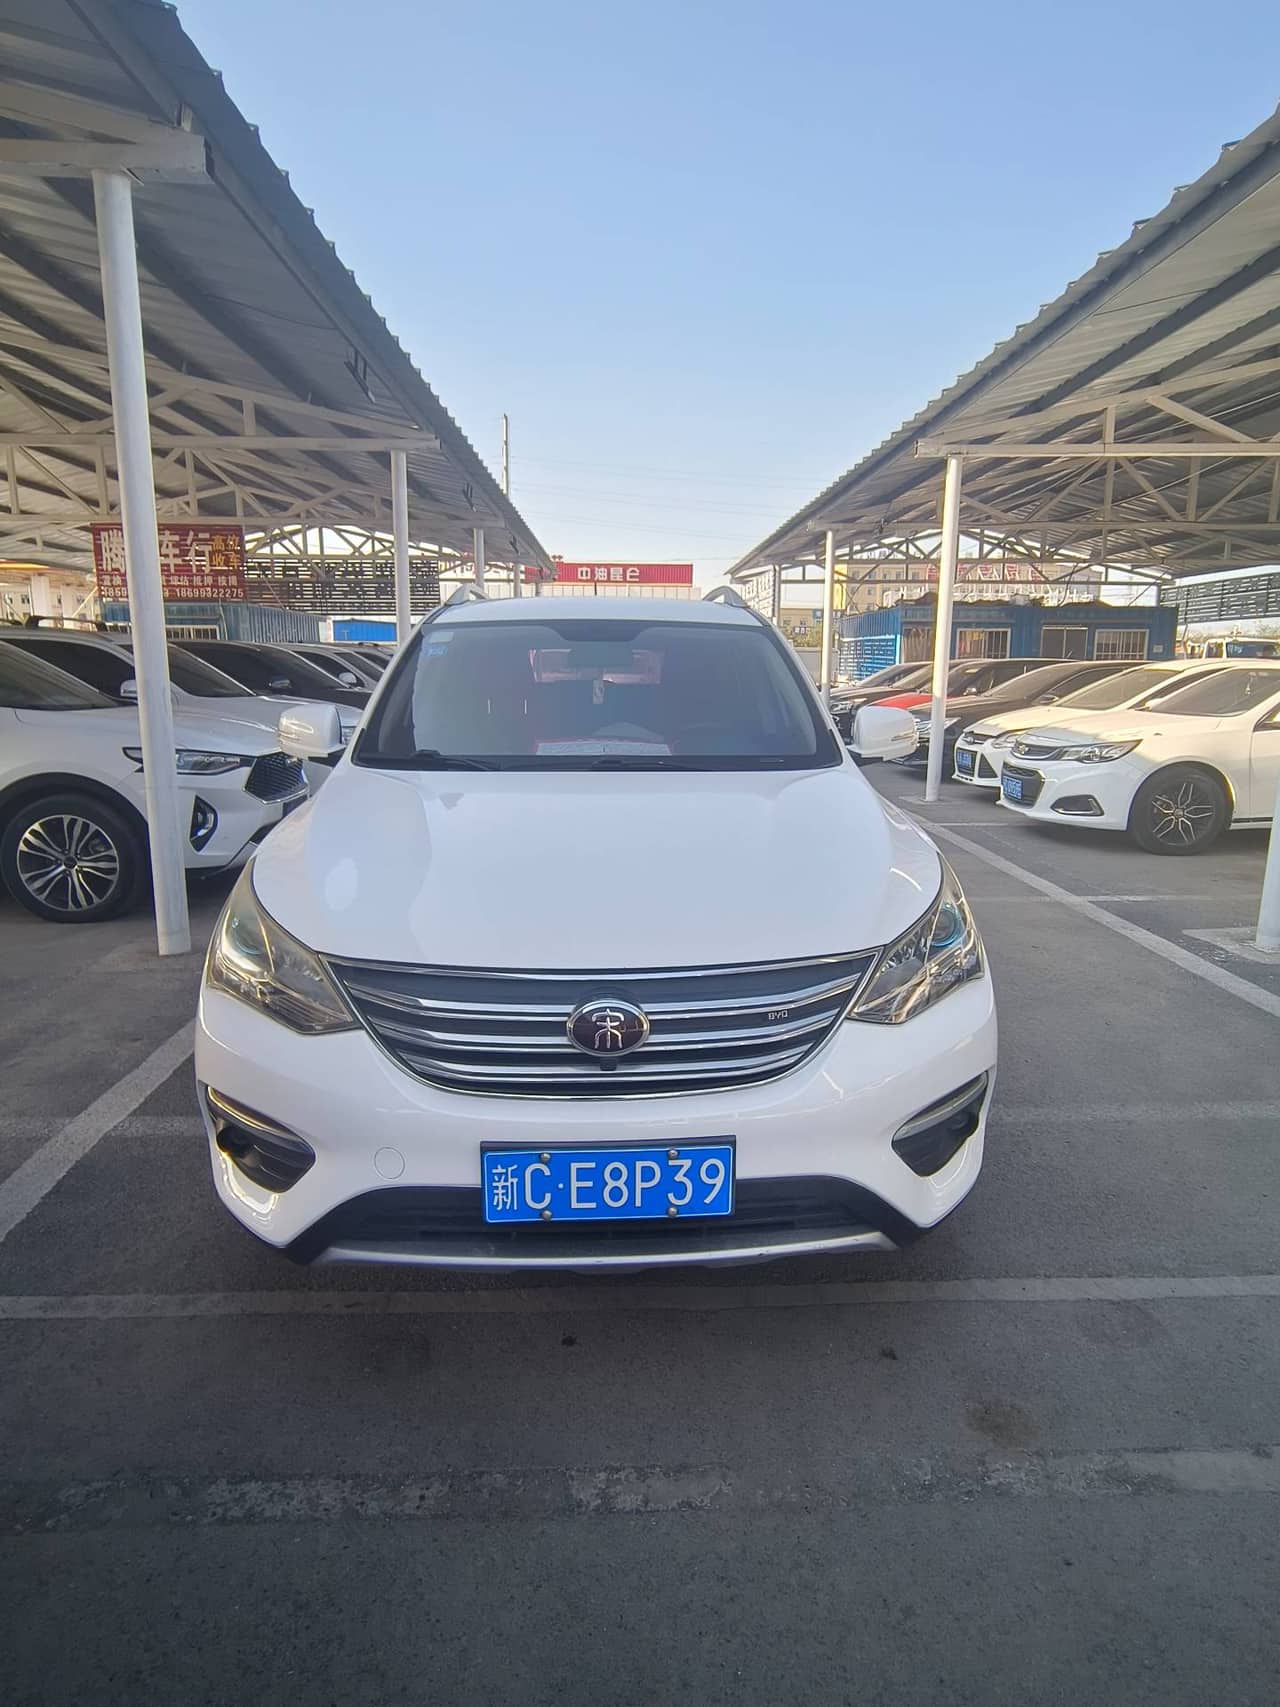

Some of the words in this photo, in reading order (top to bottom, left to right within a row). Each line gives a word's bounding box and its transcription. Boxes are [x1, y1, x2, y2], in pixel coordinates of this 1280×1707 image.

[100, 528, 213, 573] 腾车行
[212, 552, 241, 569] 收车
[577, 567, 640, 582] 中油昆仑
[768, 1010, 788, 1020] BYD
[492, 1158, 726, 1210] 新C·E8P39
